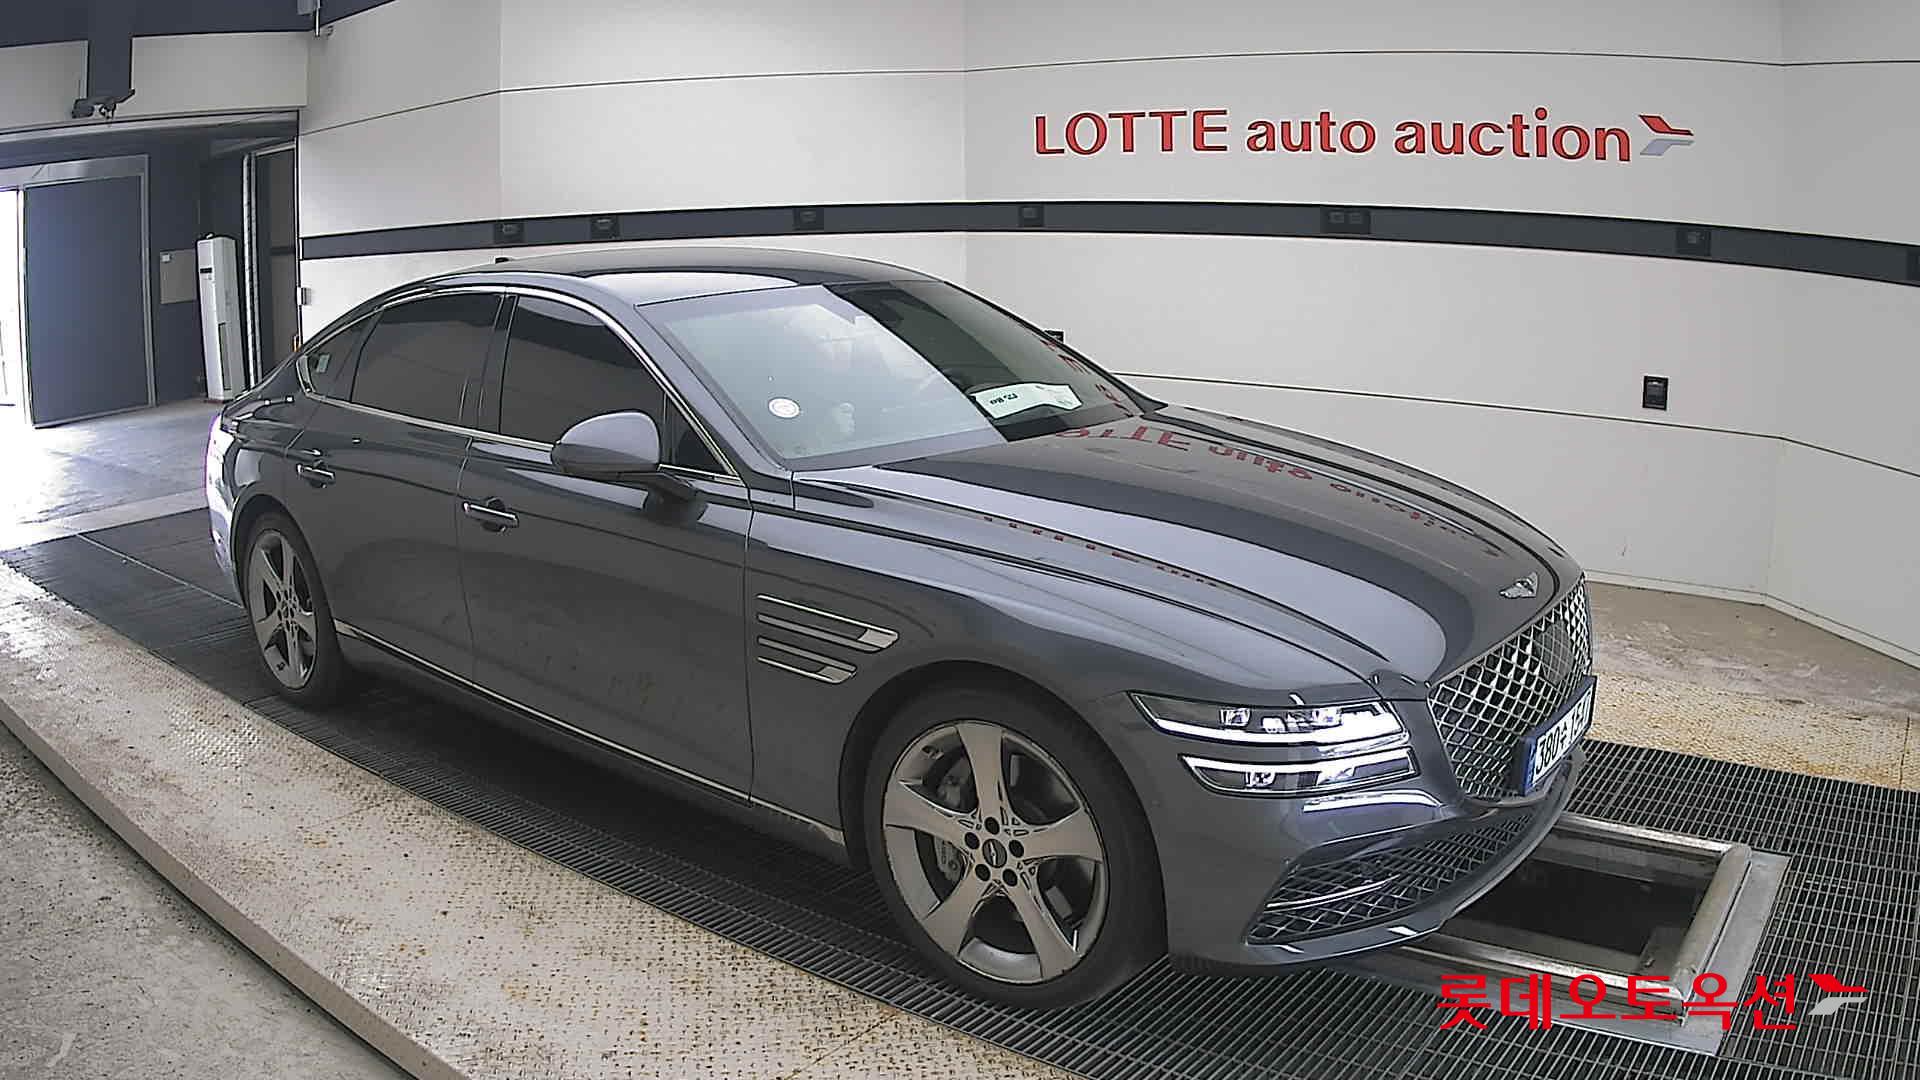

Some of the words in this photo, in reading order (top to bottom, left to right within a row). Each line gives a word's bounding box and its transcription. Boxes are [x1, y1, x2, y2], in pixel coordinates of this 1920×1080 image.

[1034, 109, 1228, 156] LOTTE
[1246, 111, 1376, 154] auto
[1394, 107, 1632, 162] auction
